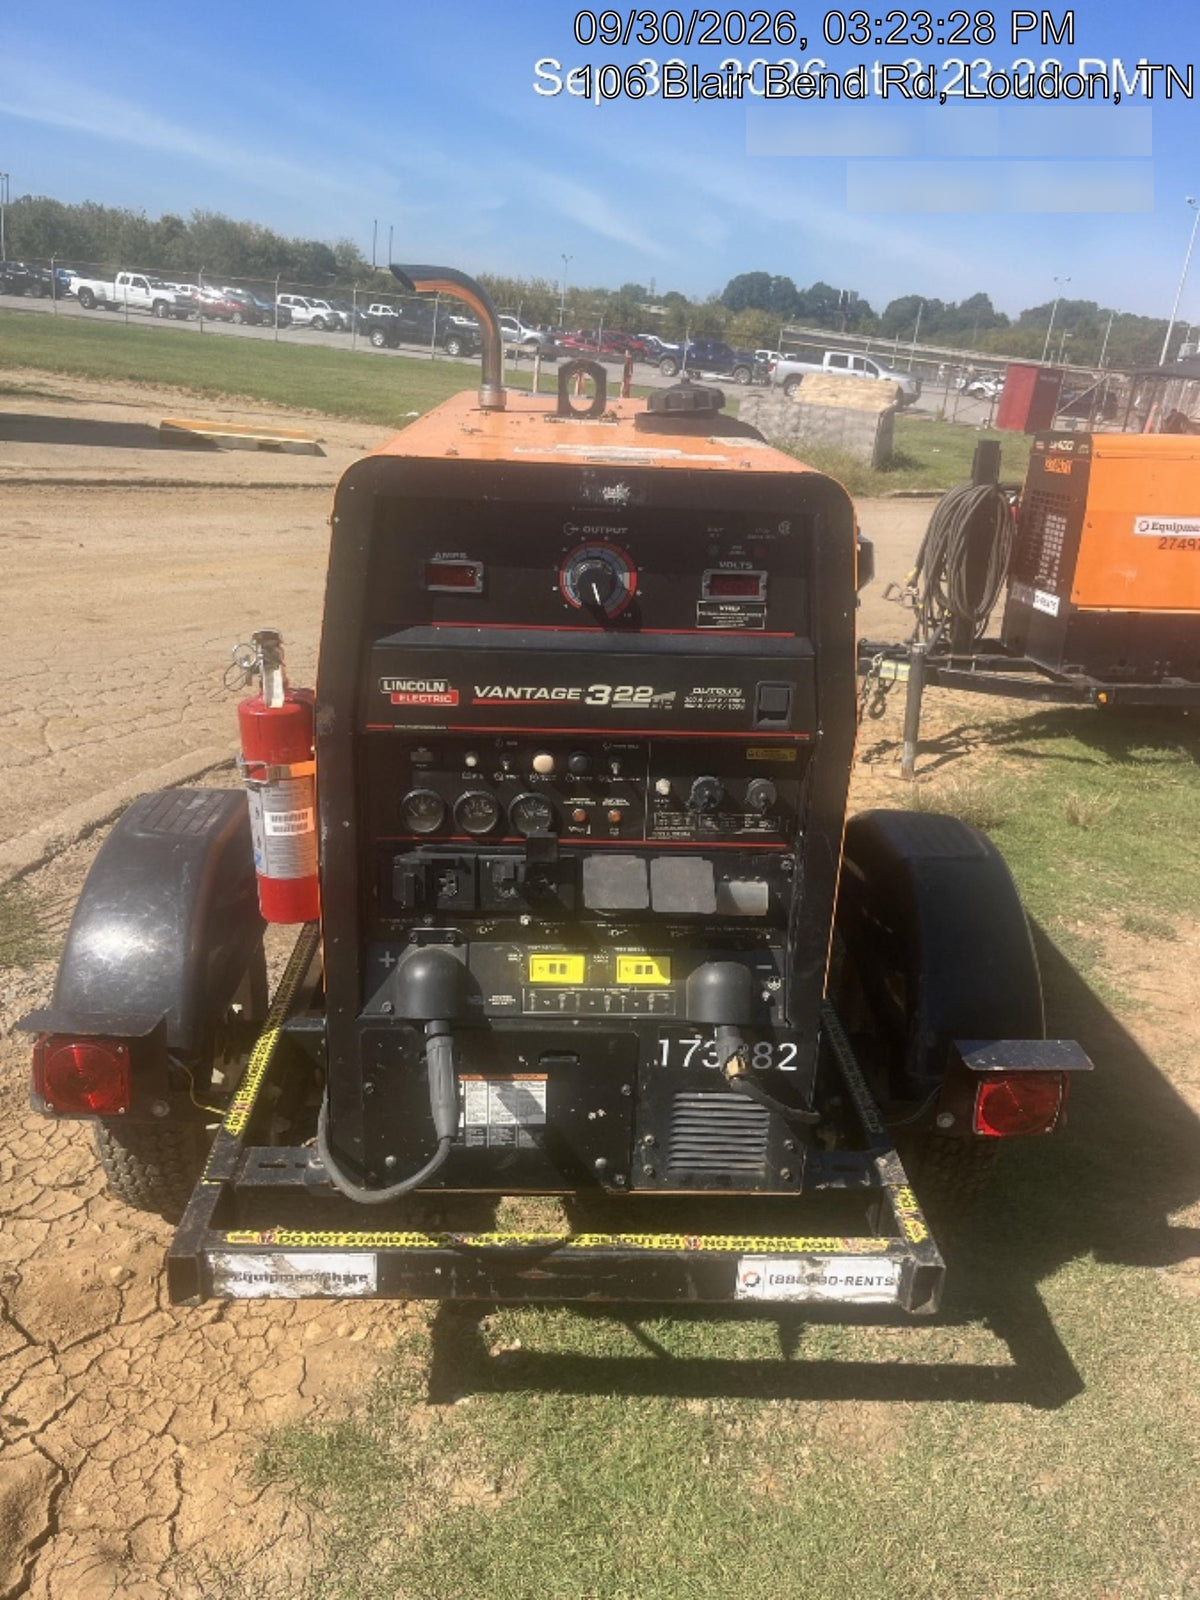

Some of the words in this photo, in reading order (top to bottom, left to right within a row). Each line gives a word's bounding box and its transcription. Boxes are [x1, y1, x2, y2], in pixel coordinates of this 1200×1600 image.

[582, 526, 629, 535] OUTPUT
[434, 552, 468, 560] AMPS
[719, 561, 754, 570] VOLTS
[383, 680, 445, 692] LINCOLN
[399, 694, 452, 704] ELECTRIC
[473, 685, 583, 700] VANTAGE
[584, 684, 654, 706] 322
[658, 1038, 798, 1071] 17382
[278, 1235, 303, 1244] DO
[307, 1235, 342, 1244] NOT
[346, 1235, 401, 1245] STAND
[703, 1239, 728, 1248] NO
[755, 1240, 799, 1249] PARE
